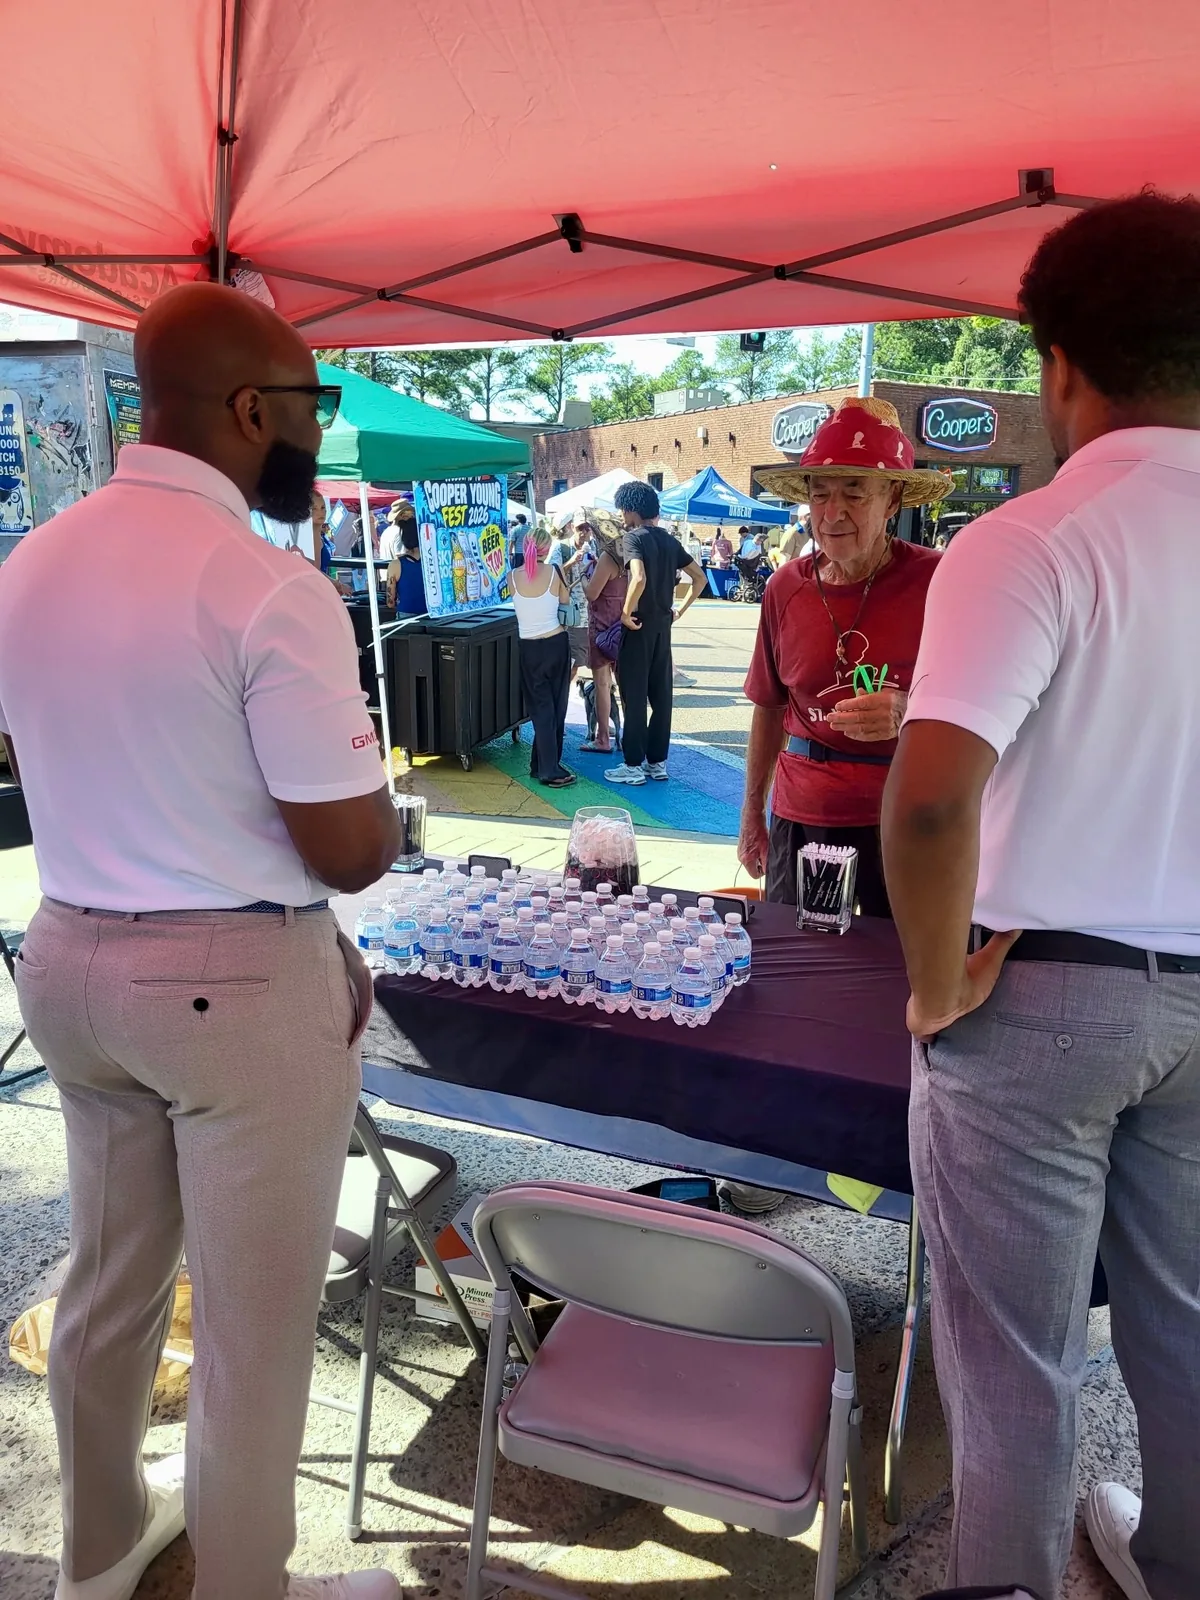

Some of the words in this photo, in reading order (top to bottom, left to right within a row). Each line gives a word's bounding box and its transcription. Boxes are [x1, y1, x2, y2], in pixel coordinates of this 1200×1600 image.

[774, 409, 829, 445] Cooper's
[927, 408, 994, 441] Cooper's
[424, 480, 468, 513] COOPER
[469, 481, 501, 511] YOUNG
[441, 504, 468, 528] FEST
[482, 533, 501, 556] BEER
[352, 731, 376, 750] GM
